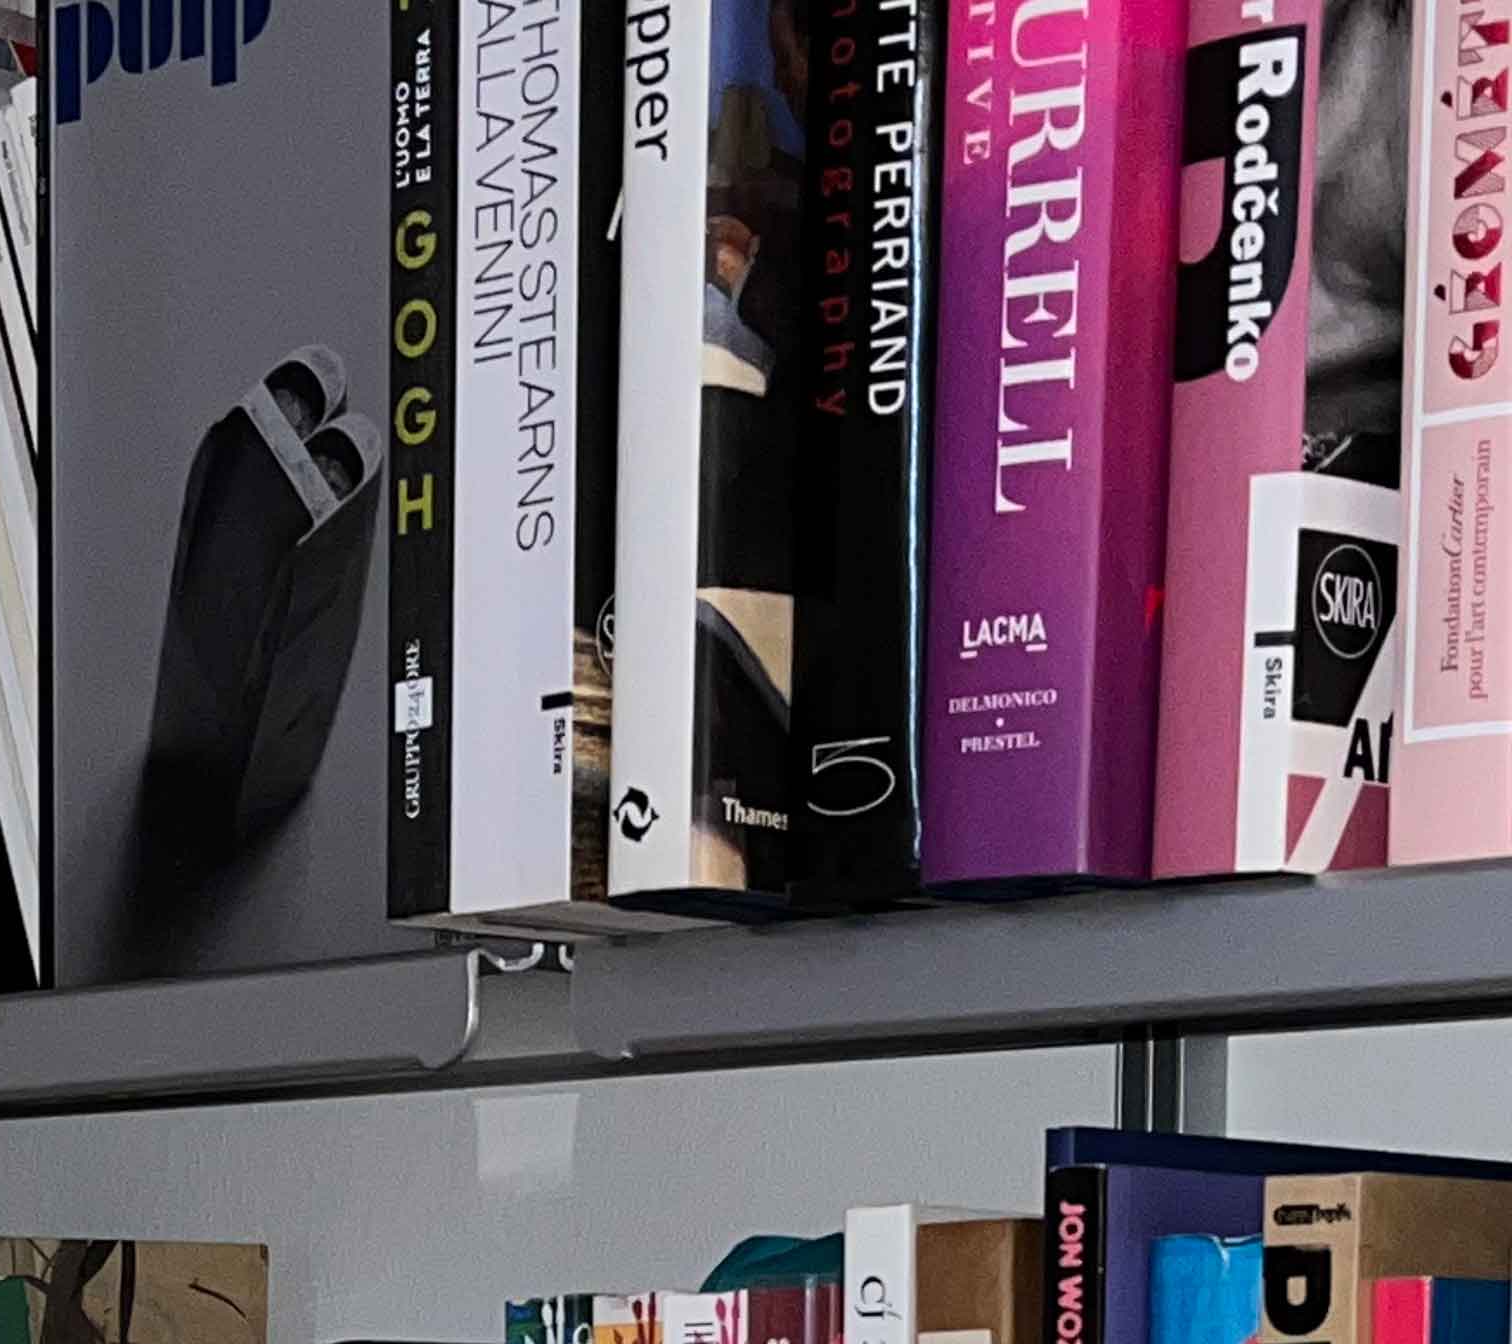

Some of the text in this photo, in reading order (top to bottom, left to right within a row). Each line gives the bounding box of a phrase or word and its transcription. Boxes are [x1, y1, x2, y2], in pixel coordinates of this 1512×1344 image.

[415, 28, 431, 183] E LA TERRA
[474, 0, 517, 365] ALLA VENINI
[517, 0, 560, 551] THOMAS STEARNS
[867, 120, 913, 416] PERRIAND
[995, 0, 1089, 514] URRELL
[1225, 36, 1299, 382] Rodčenko
[394, 210, 438, 535] GOGH
[961, 612, 1048, 659] LACMA
[1319, 572, 1377, 630] SKIRA
[1464, 439, 1494, 700] pour l'art contemporain
[553, 718, 565, 775] Skira
[949, 687, 1058, 715] DELMONICO
[960, 732, 1040, 754] PRESTEL
[1263, 658, 1283, 719] Skira
[1057, 1201, 1087, 1267] JON
